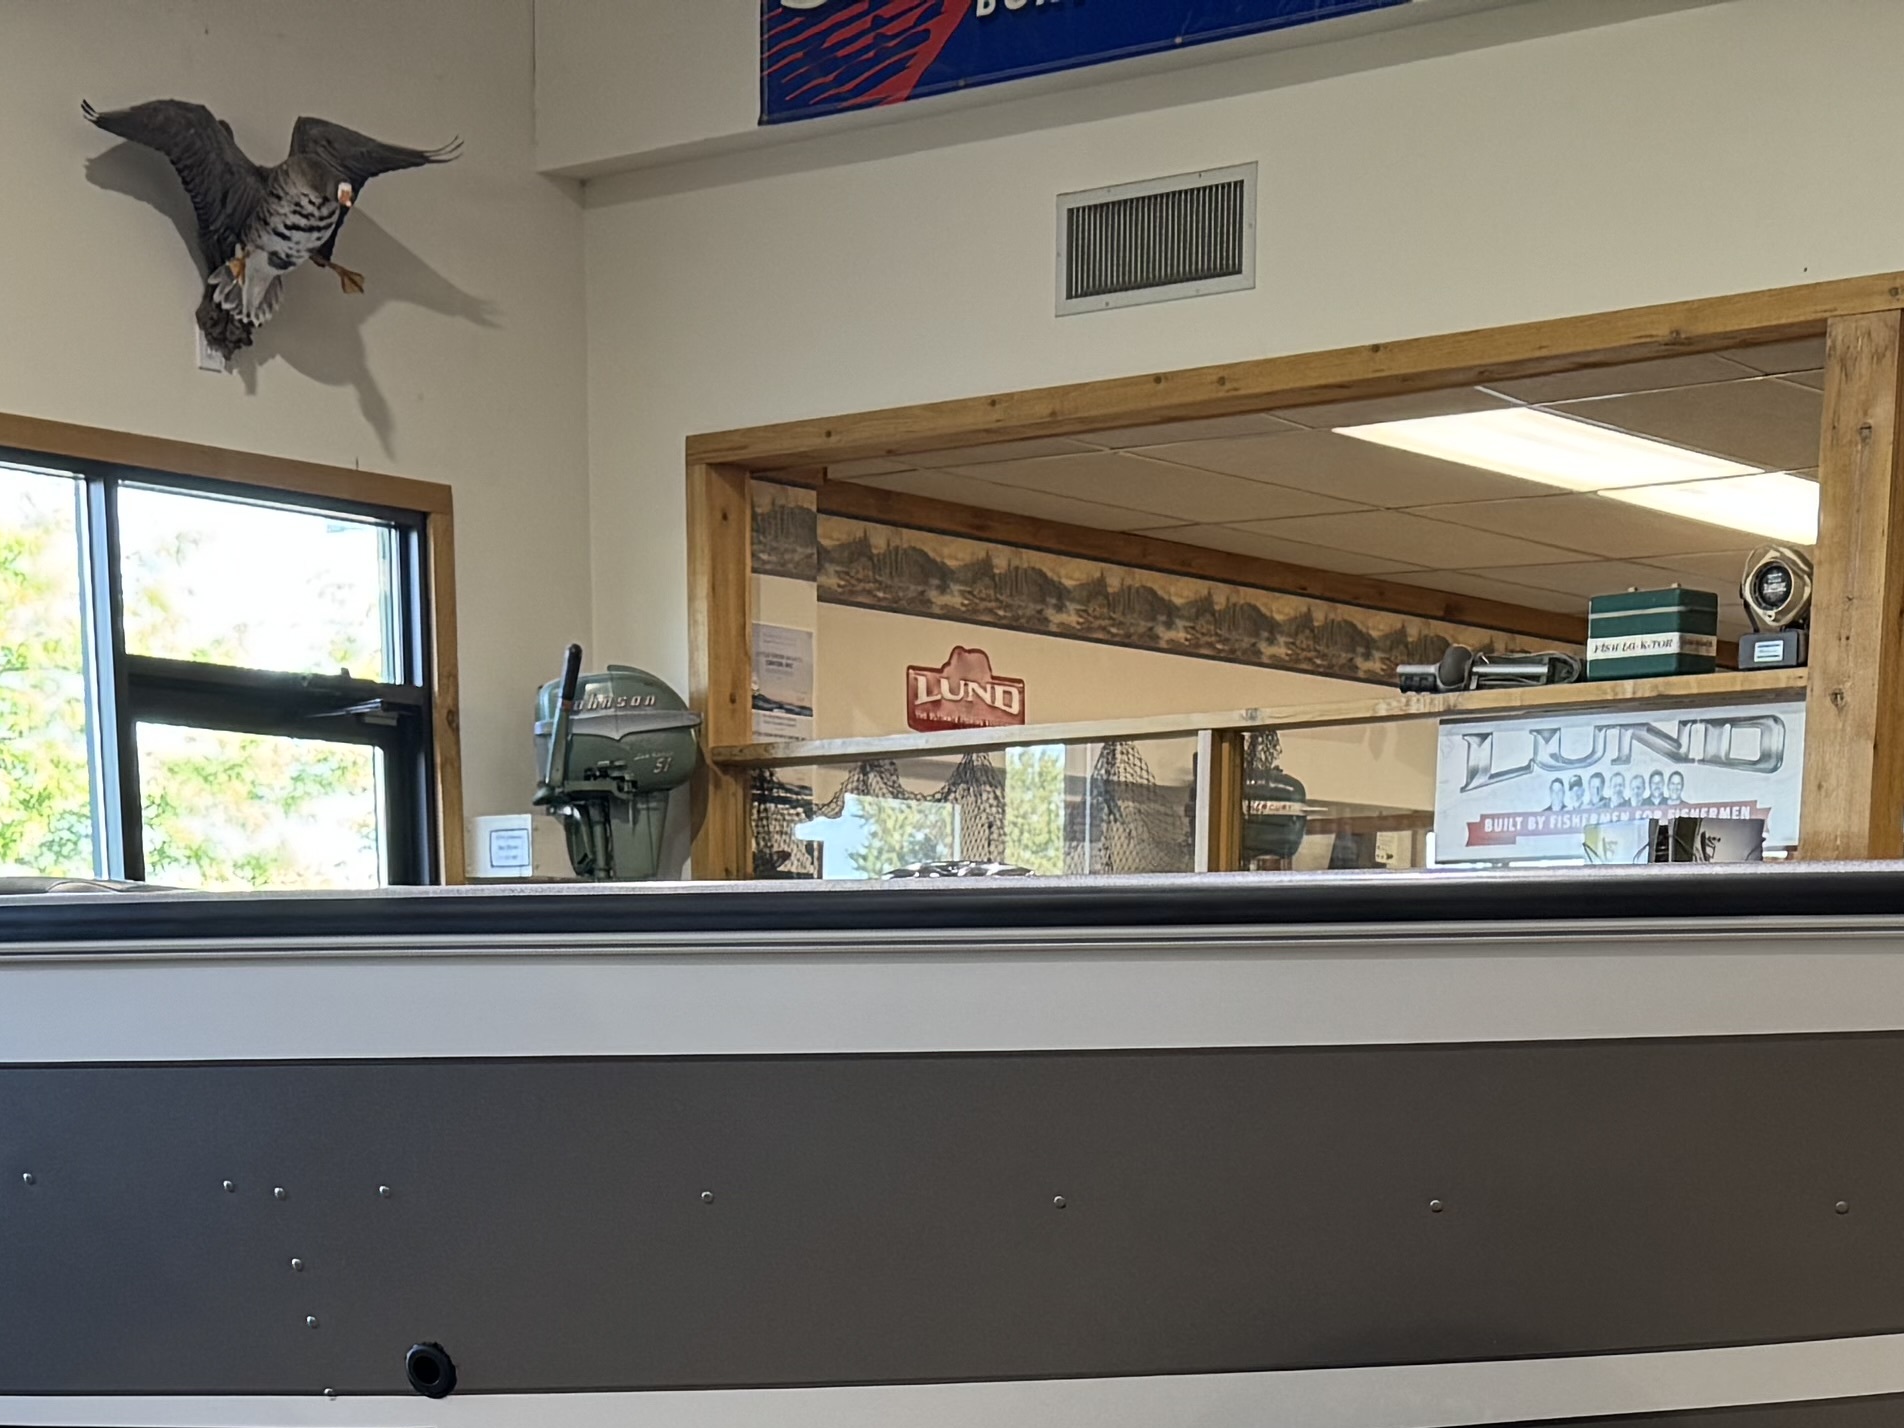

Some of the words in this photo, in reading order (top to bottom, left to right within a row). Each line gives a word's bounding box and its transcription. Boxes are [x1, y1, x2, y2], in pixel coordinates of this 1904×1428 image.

[915, 676, 1021, 715] LUND
[1460, 714, 1786, 793] LUND
[1484, 816, 1521, 832] BUILT
[1527, 814, 1545, 829] BY
